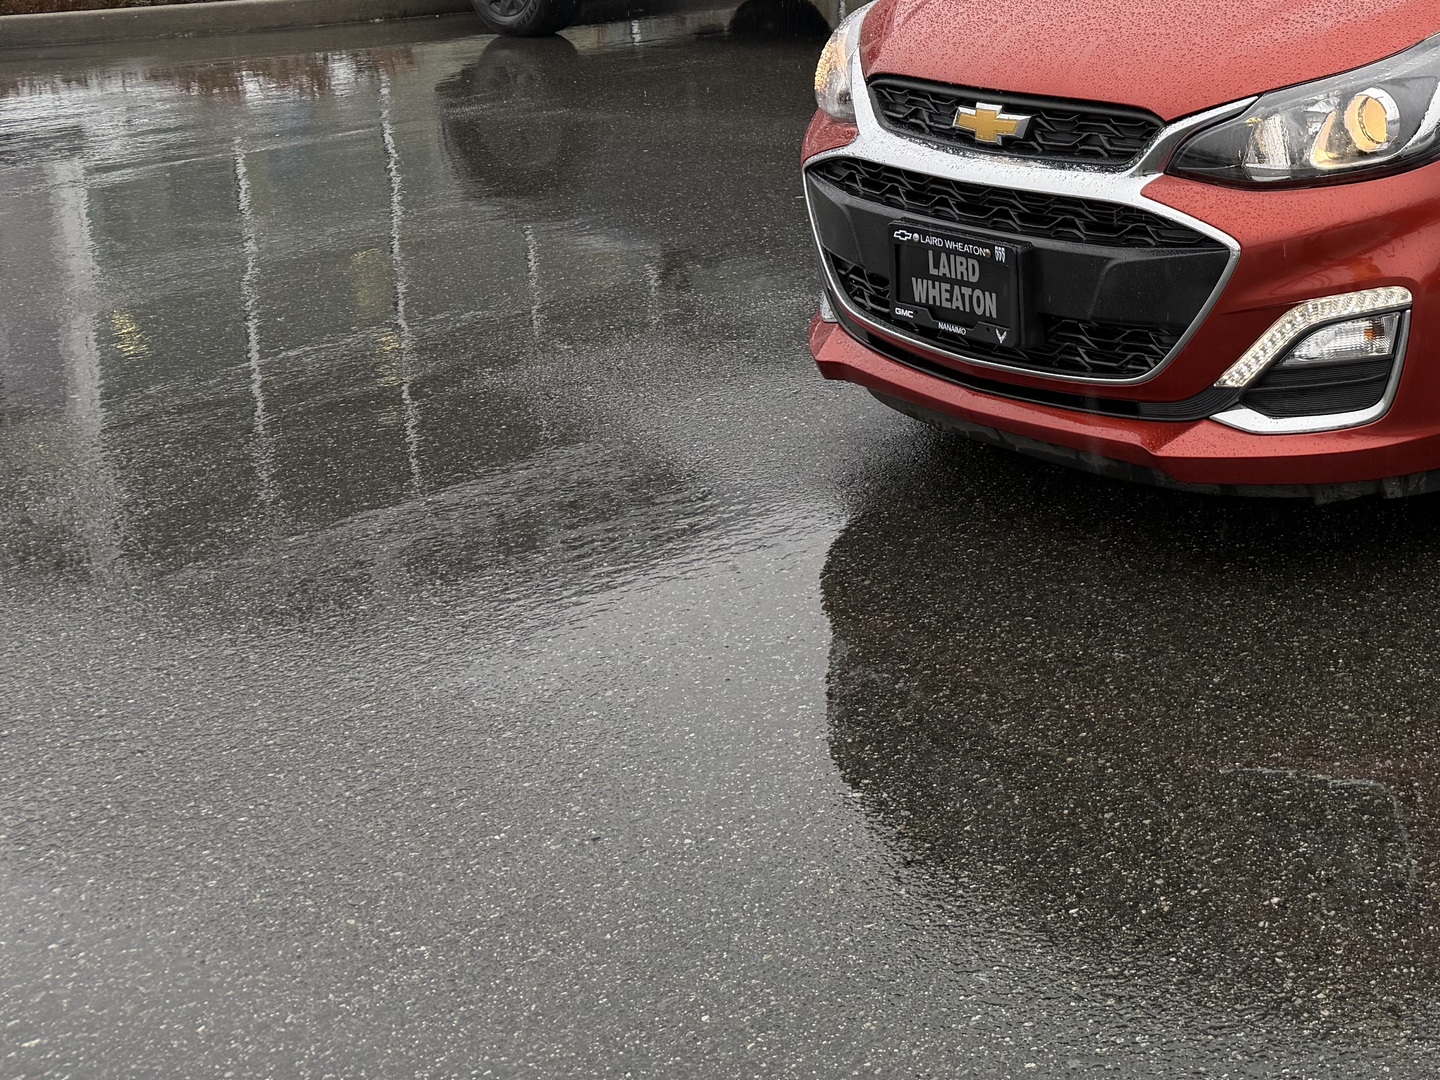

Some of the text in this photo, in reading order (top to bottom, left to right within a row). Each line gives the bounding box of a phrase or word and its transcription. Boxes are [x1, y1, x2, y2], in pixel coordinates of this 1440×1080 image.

[920, 234, 986, 257] LAIRD WHEATON
[928, 250, 980, 283] LAIRD
[912, 277, 997, 319] WHEATON
[895, 307, 914, 318] GMC
[938, 322, 967, 336] NANAIMO
